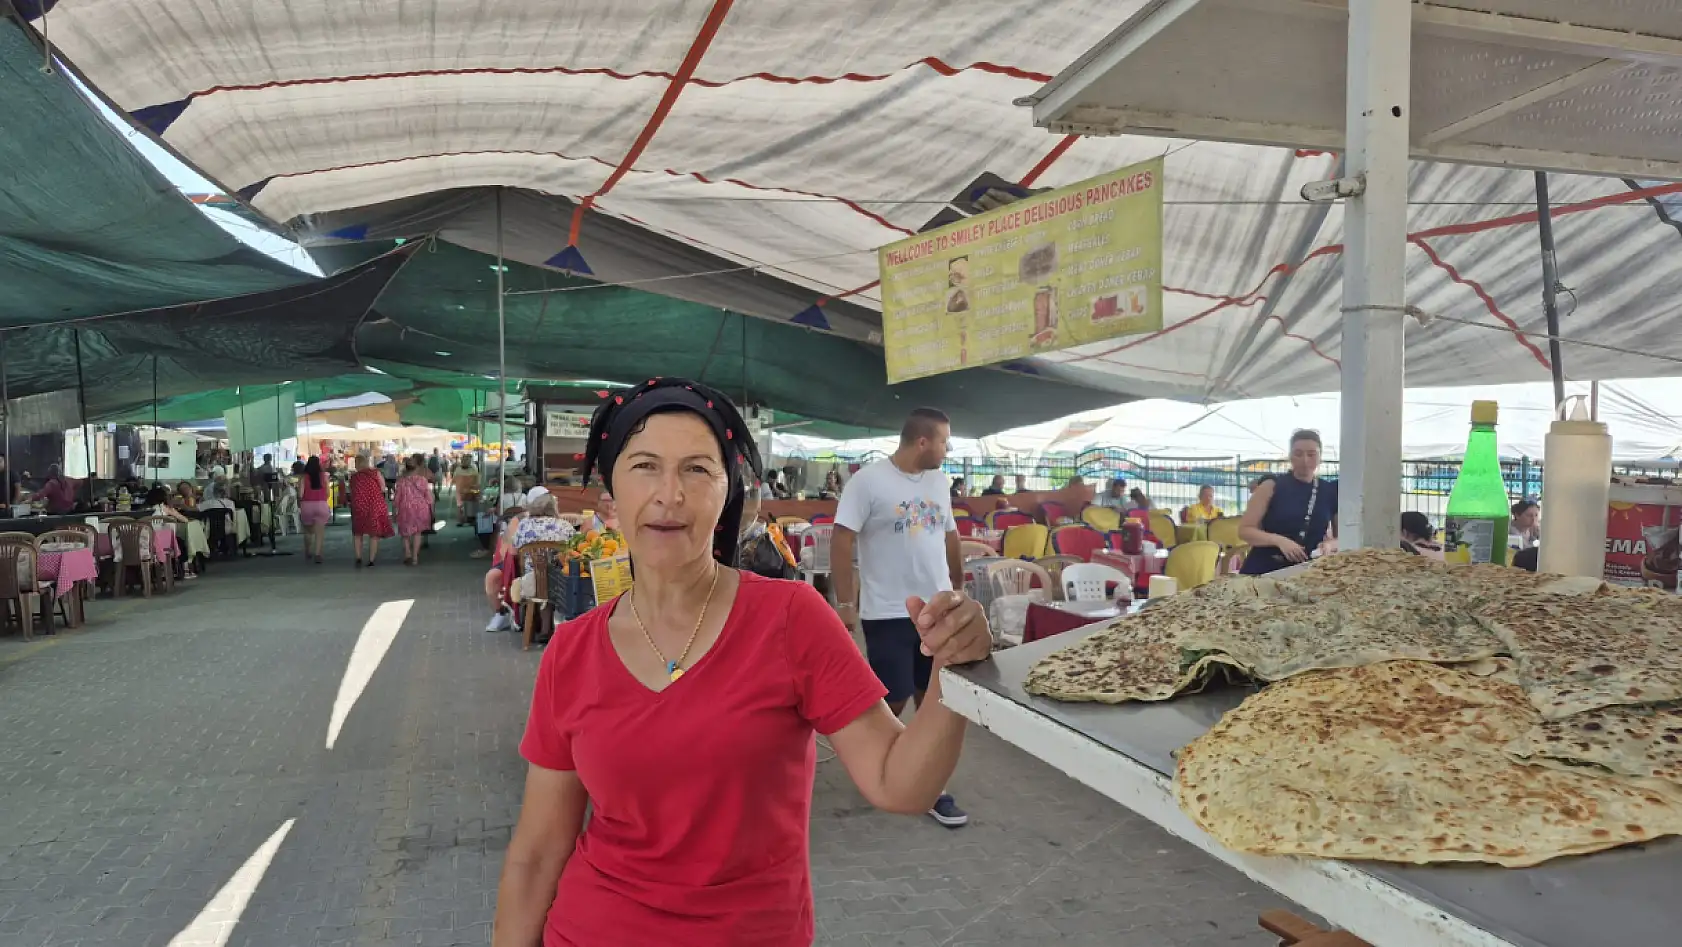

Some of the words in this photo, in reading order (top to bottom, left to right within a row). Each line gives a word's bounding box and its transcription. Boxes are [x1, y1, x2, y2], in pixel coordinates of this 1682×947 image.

[885, 240, 933, 266] WELLCOME
[936, 233, 948, 252] TO
[950, 223, 985, 246] SMILEY
[988, 212, 1020, 235] PLACE
[1023, 192, 1082, 224] DELISIOUS
[1086, 170, 1153, 205] PANCAKES
